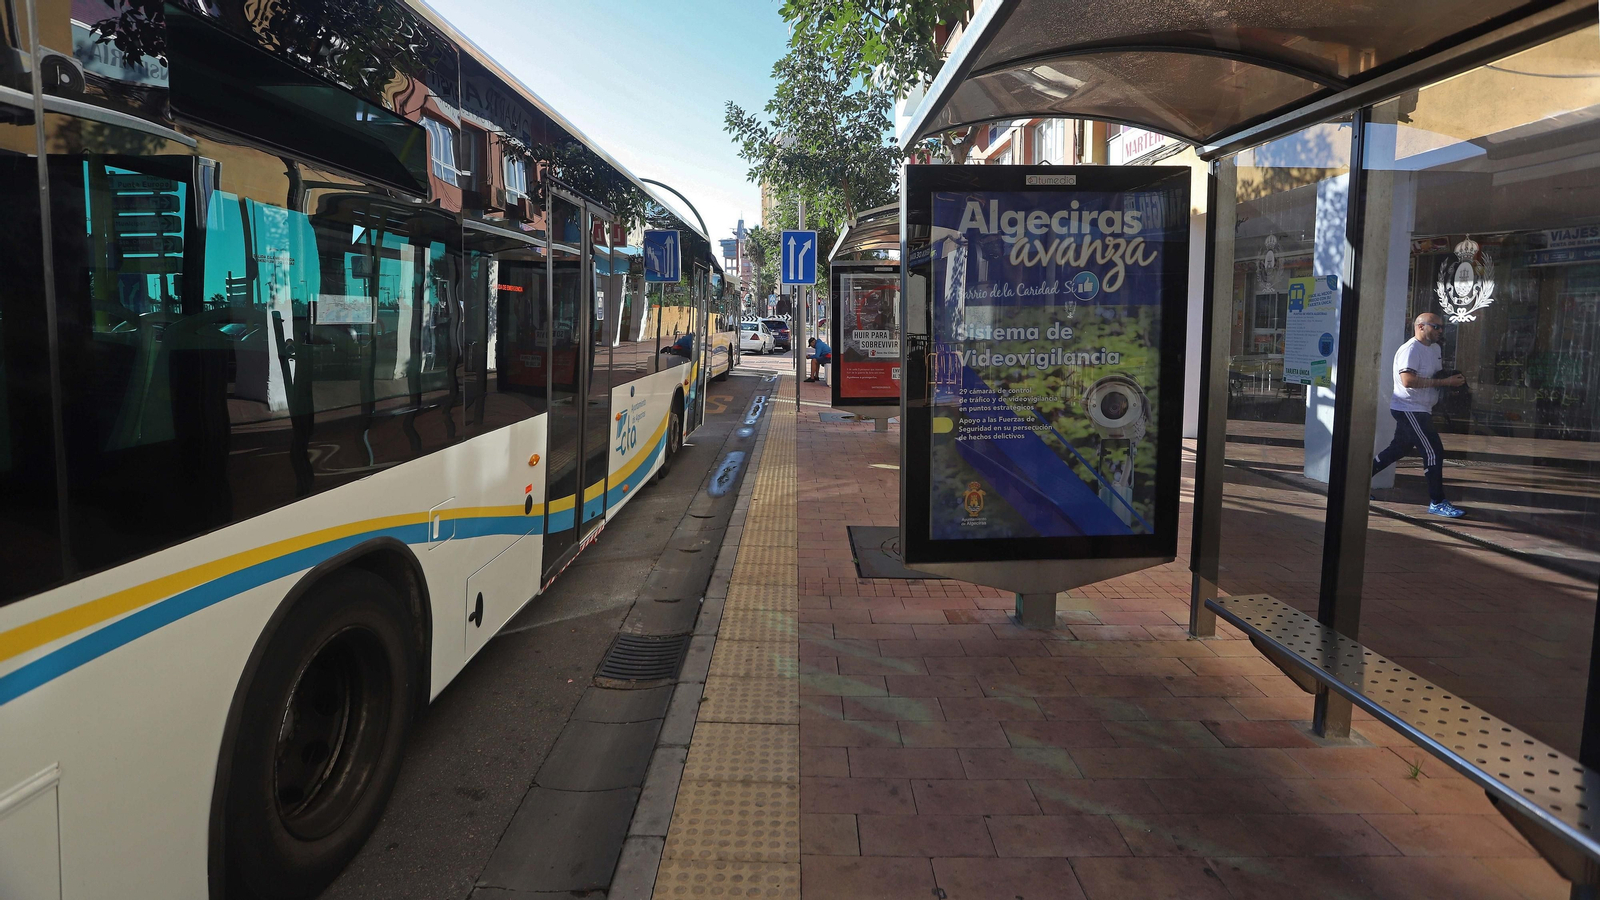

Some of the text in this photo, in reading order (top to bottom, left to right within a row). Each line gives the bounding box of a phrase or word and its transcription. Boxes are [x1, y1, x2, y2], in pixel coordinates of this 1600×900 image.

[1038, 176, 1074, 184] tumedio
[958, 199, 1143, 244] Algeciras
[1551, 226, 1599, 242] VIAJES
[1010, 234, 1158, 293] avanza
[990, 283, 1004, 298] de
[1004, 282, 1015, 298] la
[1016, 280, 1060, 296] Caridad
[1064, 280, 1077, 294] Sí
[956, 322, 1073, 340] Sistema de
[957, 348, 1120, 370] Videovigilancia
[616, 414, 637, 456] cta
[959, 425, 991, 433] Seguridad
[1013, 424, 1052, 432] persecución
